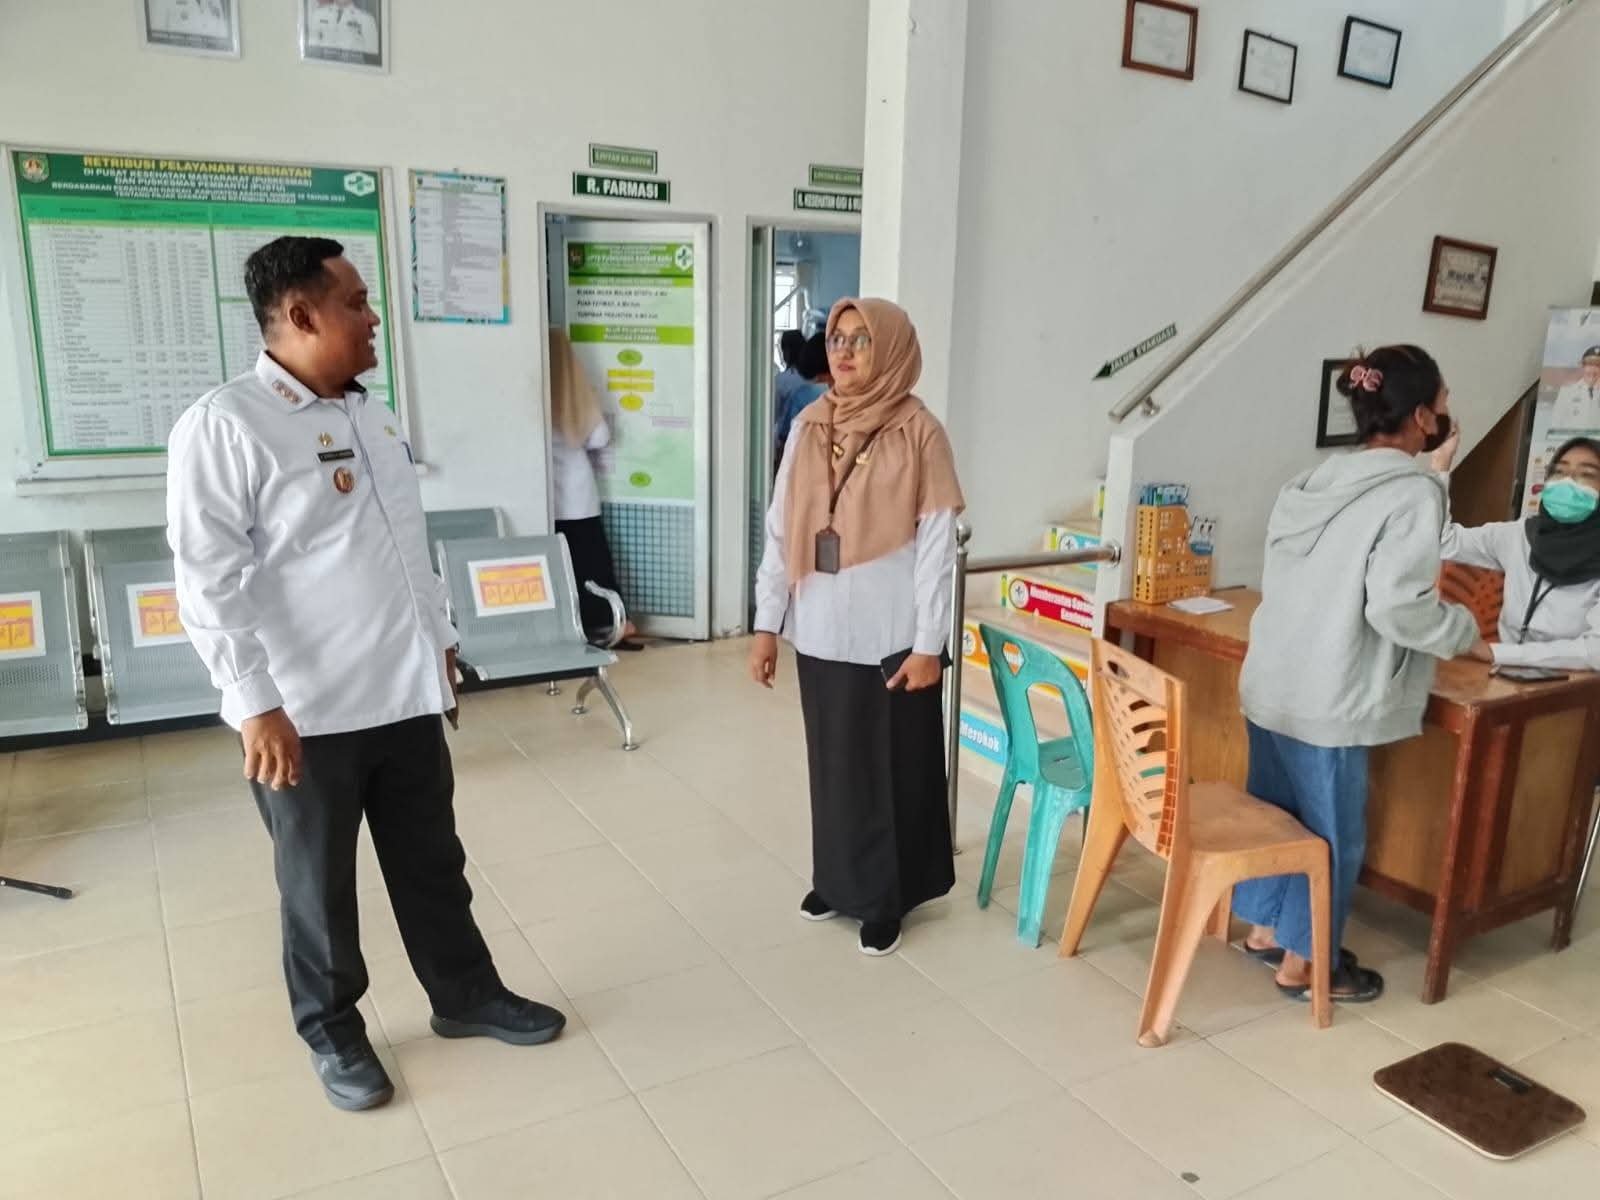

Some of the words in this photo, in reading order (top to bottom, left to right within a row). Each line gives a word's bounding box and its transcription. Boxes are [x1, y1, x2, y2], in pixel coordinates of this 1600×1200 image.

[84, 157, 155, 170] RETRIBUSI
[160, 159, 235, 174] PELAYANAN
[239, 164, 312, 179] KESEHATAN
[84, 168, 94, 176] DI
[96, 168, 127, 178] PUSAT
[129, 170, 186, 180] KESEHATAN
[188, 173, 249, 183] MASYARAKAT
[52, 181, 112, 192] BERDASARKAN
[586, 177, 601, 194] R.
[603, 179, 659, 199] FARMASI
[958, 719, 1000, 753] Merokok
